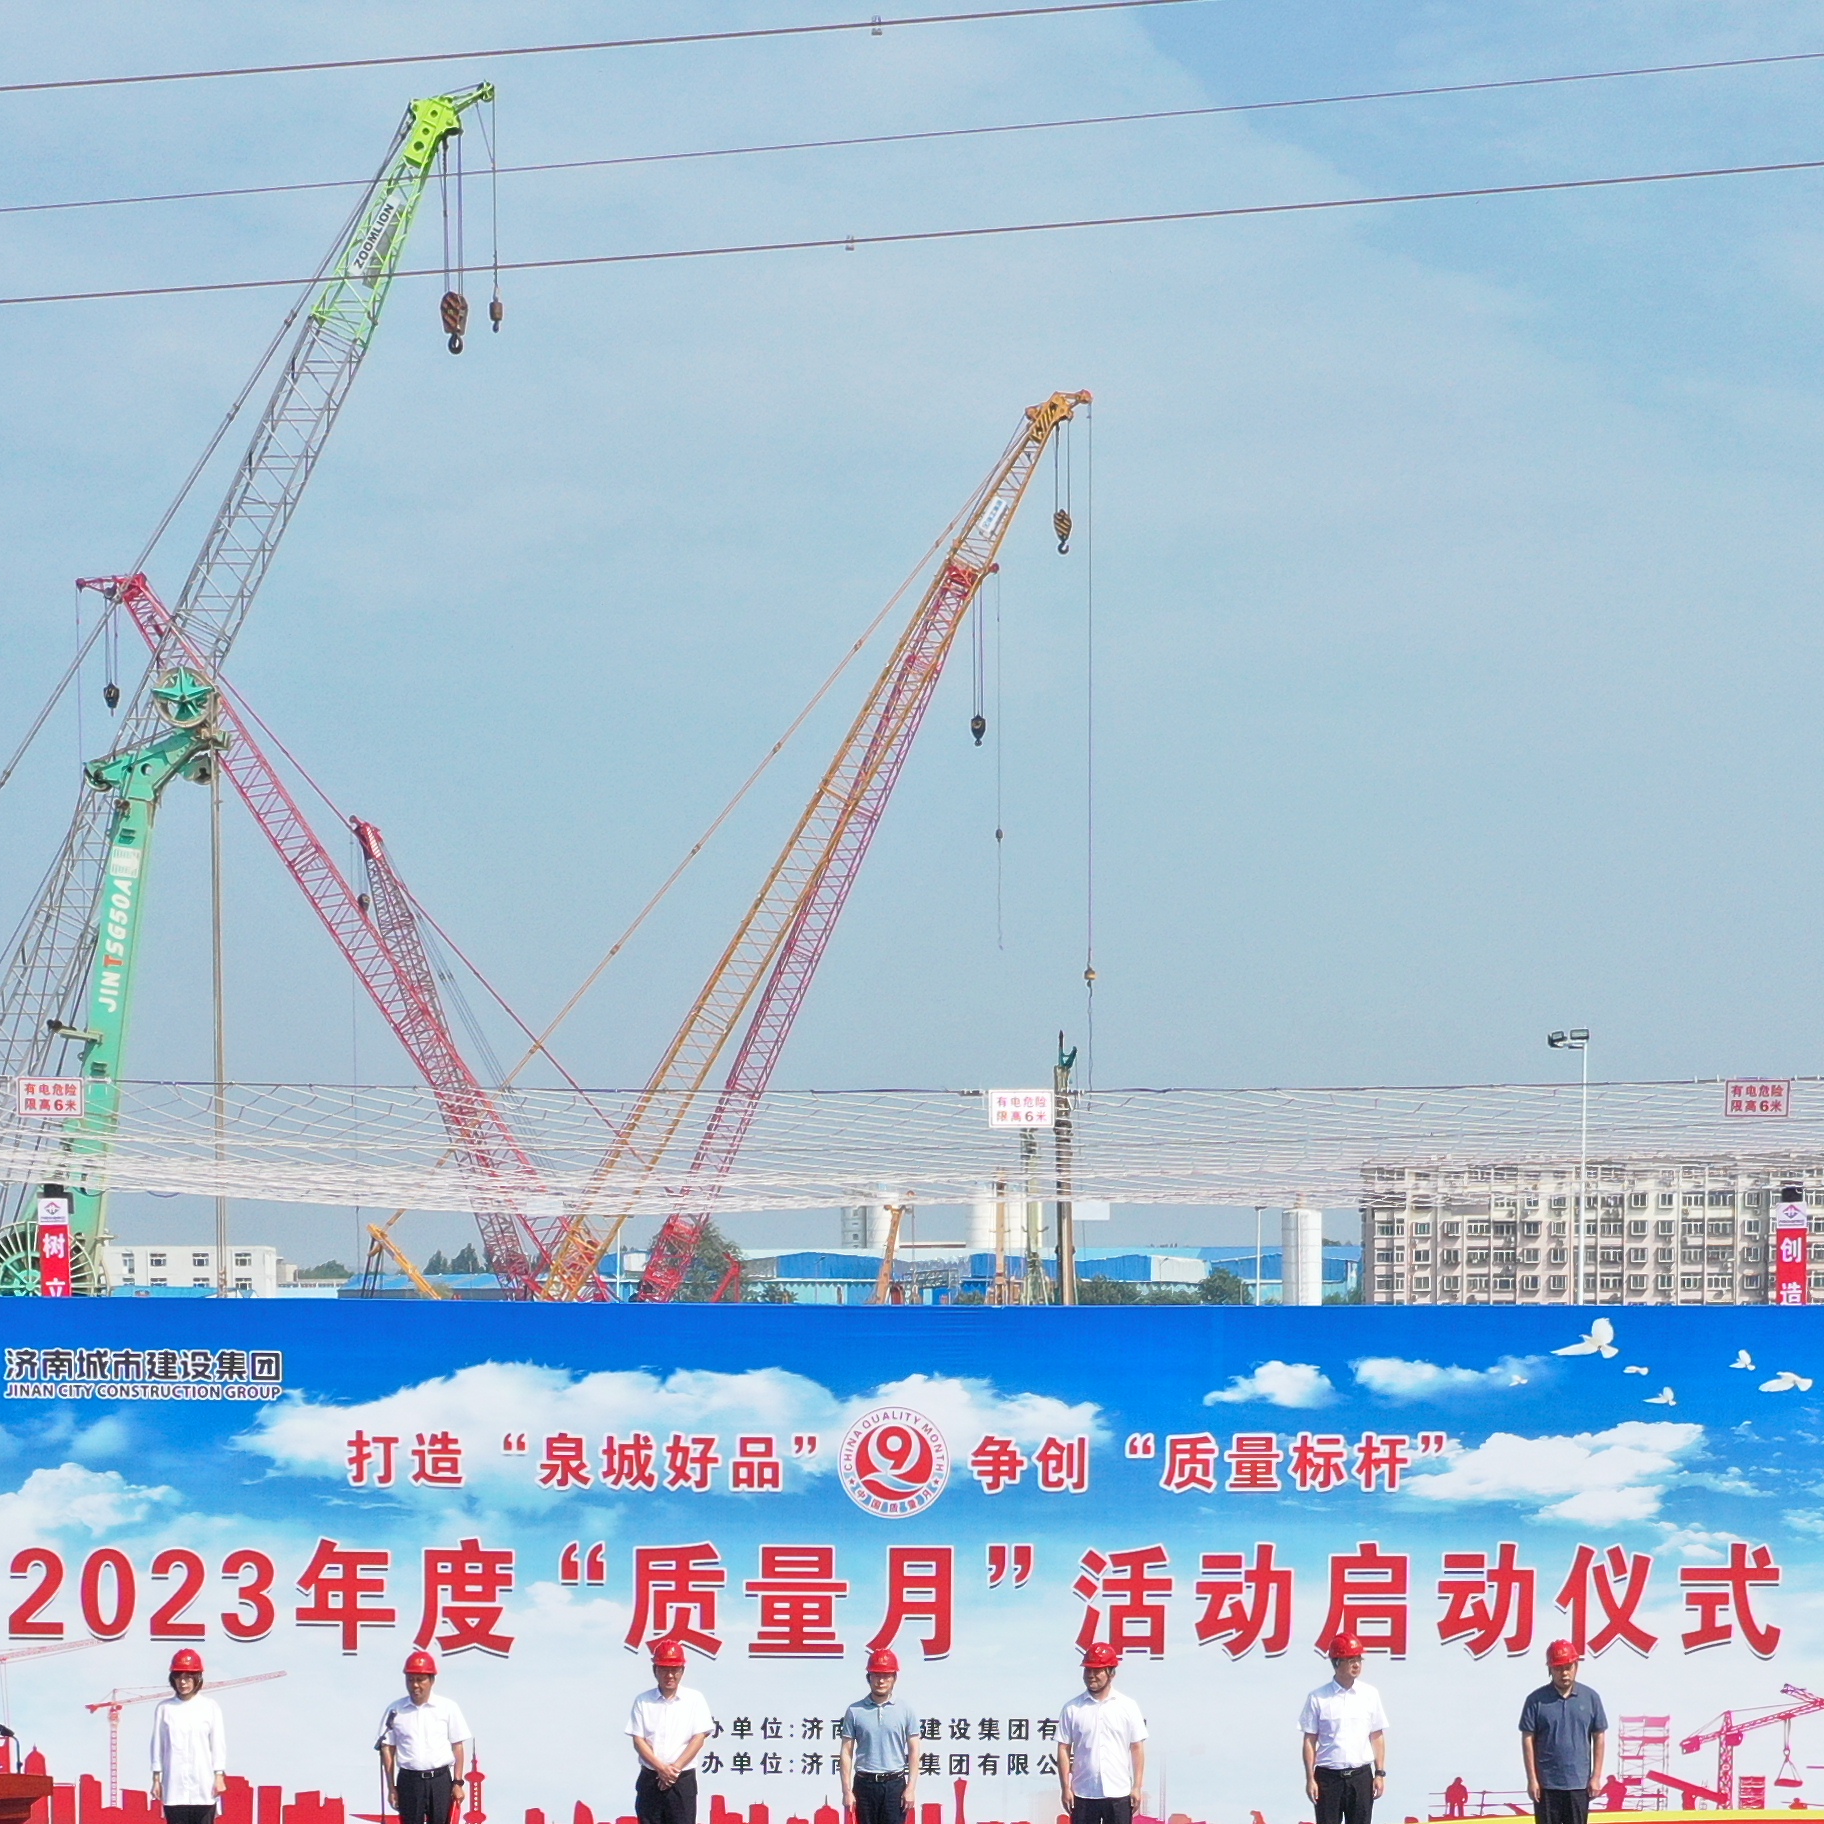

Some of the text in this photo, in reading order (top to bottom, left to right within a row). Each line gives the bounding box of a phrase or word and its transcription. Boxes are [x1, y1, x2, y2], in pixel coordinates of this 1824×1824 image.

[24, 1083, 78, 1097] 有电危险
[1730, 1085, 1784, 1097] 有电危险
[24, 1099, 78, 1112] 限高6米
[996, 1095, 1047, 1108] 有电危险
[1730, 1099, 1783, 1112] 限高6米
[996, 1110, 1047, 1123] 限高6米
[4, 1349, 283, 1383] 济南城市建设集团
[6, 1384, 281, 1401] JINAN CITY CONSTRUCTION GROUP
[844, 1410, 945, 1471] CHINA QUALITY MONTH
